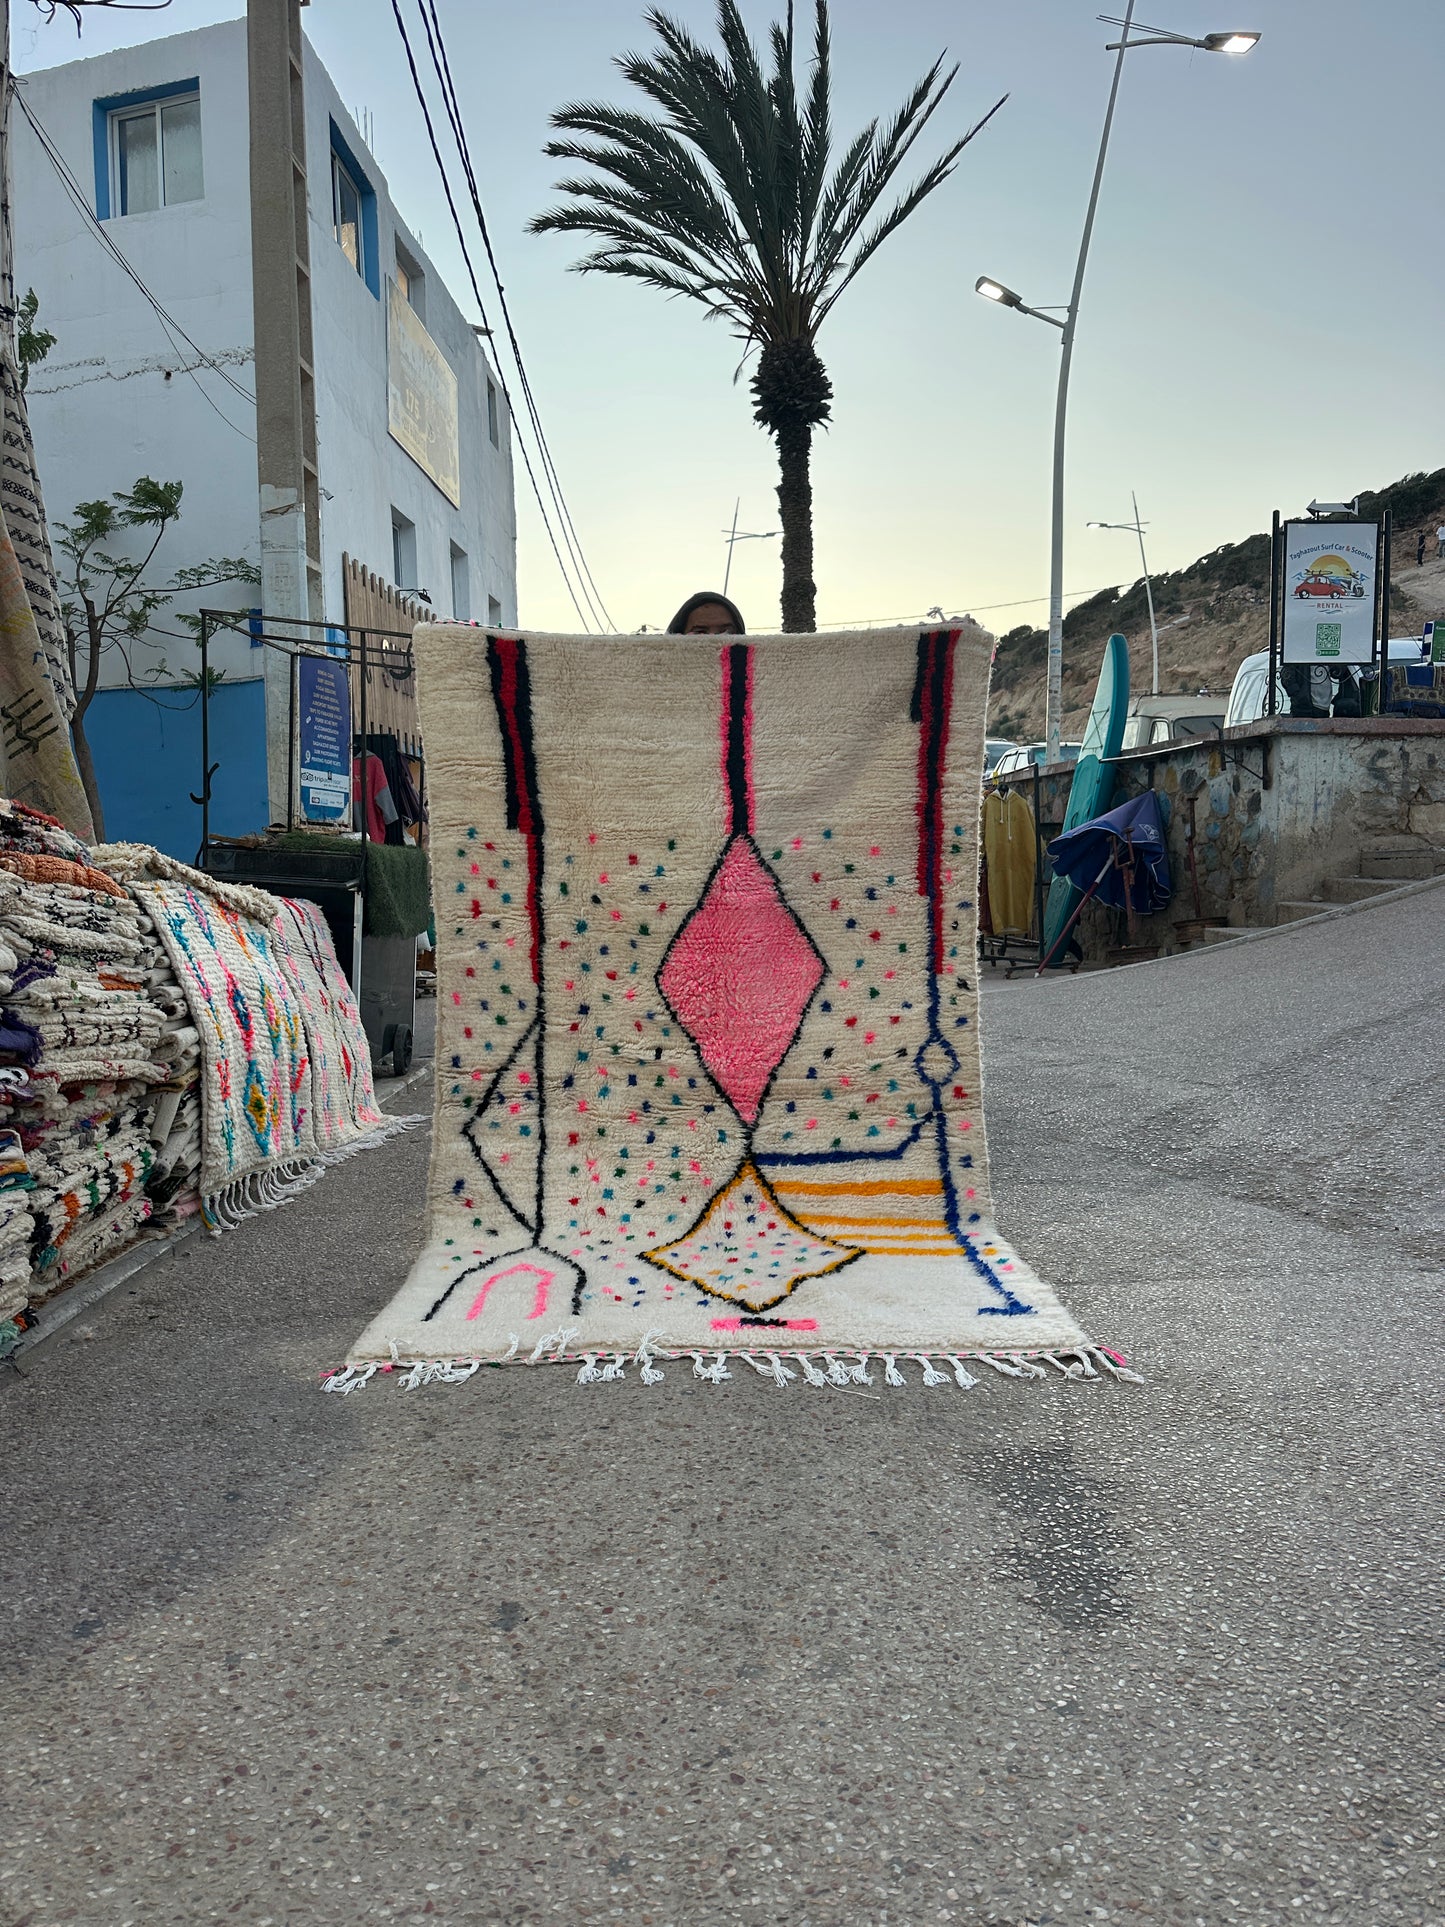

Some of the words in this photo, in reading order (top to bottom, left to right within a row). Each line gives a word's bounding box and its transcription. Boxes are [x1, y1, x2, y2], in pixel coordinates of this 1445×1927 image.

[405, 388, 420, 420] 175
[1289, 545, 1320, 560] Taghazout
[1321, 543, 1334, 551] Surf
[1335, 543, 1345, 551] Car
[1351, 546, 1374, 561] Scooter
